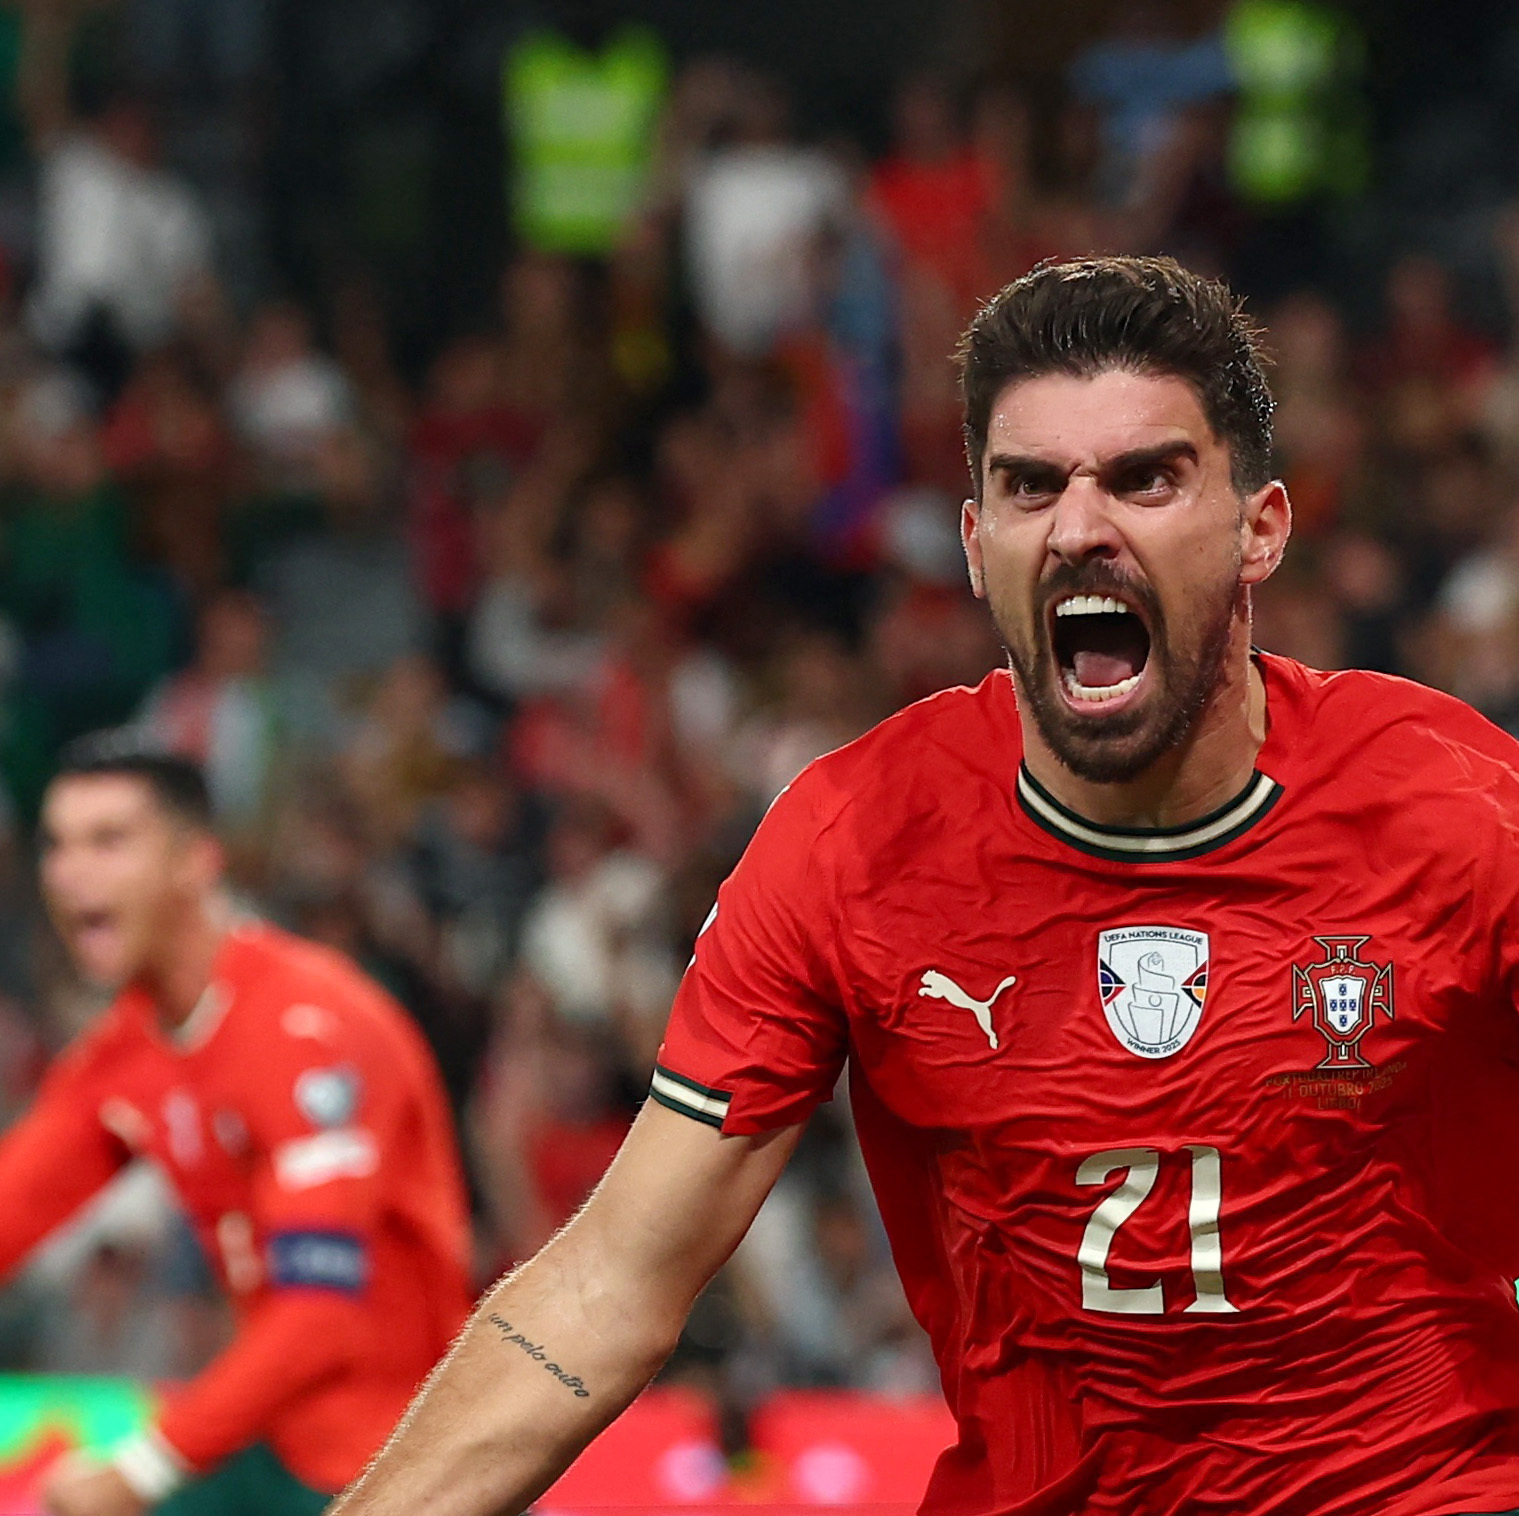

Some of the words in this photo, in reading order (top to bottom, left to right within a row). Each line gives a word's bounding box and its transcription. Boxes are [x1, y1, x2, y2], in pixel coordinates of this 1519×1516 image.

[1104, 930, 1127, 943] UEFA
[1128, 930, 1168, 939] NATIONS
[1169, 931, 1204, 945] LEAGUE
[1126, 1037, 1161, 1054] WINNER
[1162, 1040, 1182, 1054] 2025
[1299, 1081, 1364, 1097] OUTUBRO
[1076, 1145, 1241, 1314] 21
[501, 1334, 547, 1360] pelo
[544, 1363, 590, 1397] outro
